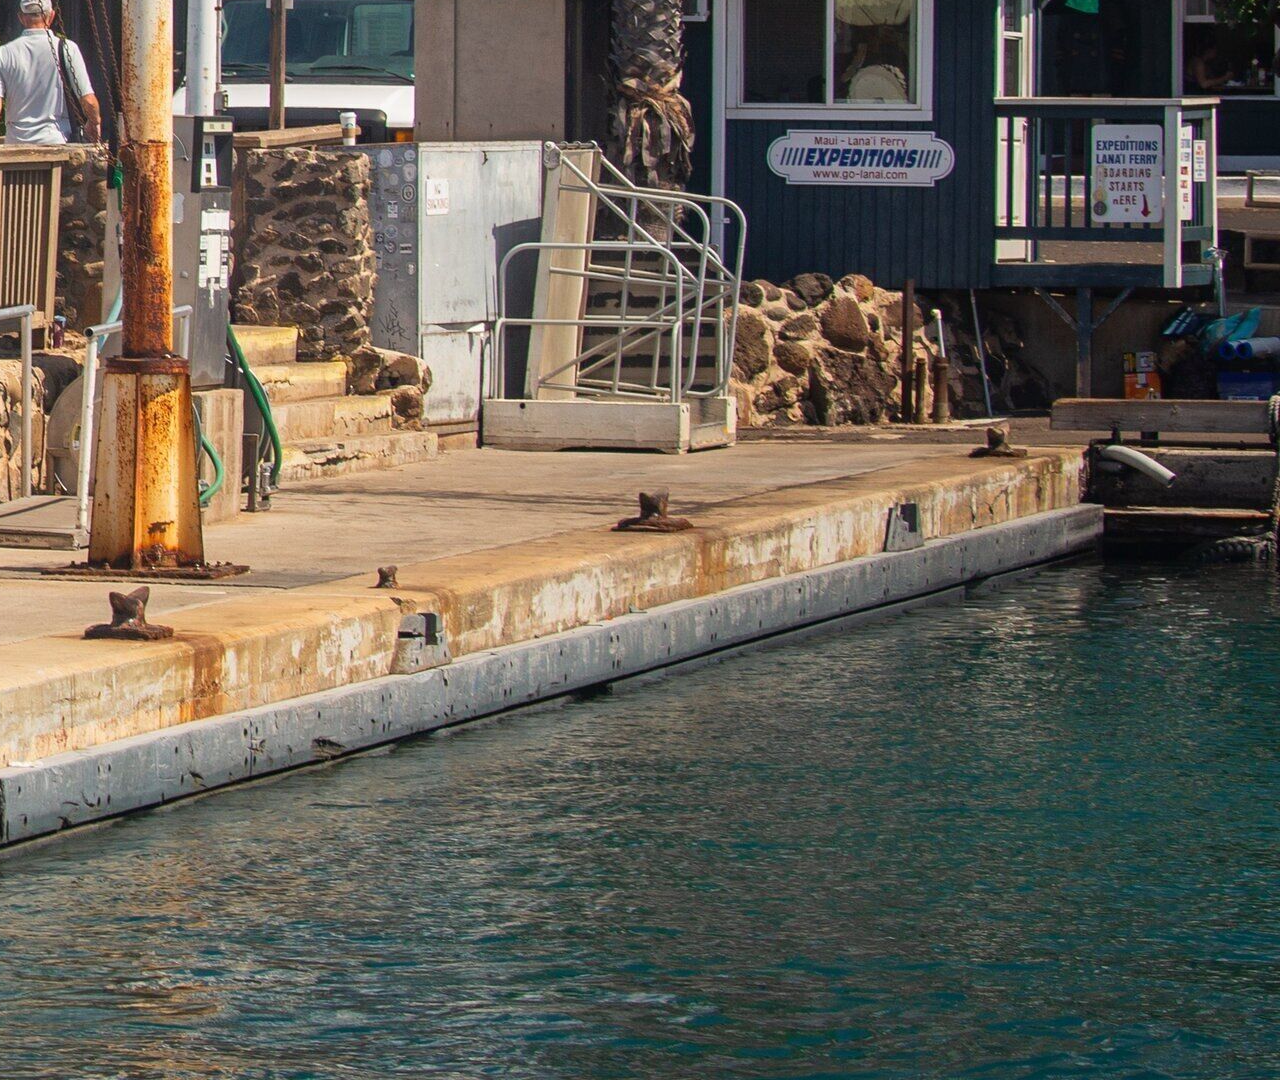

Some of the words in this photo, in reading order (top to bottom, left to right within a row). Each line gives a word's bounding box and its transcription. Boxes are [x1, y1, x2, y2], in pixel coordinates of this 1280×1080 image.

[814, 136, 838, 146] Maui
[880, 138, 908, 148] Ferry
[1096, 140, 1158, 151] EXPEDITIONS
[804, 148, 918, 168] EXPEDITIONS
[1129, 154, 1158, 165] FERRY
[812, 170, 908, 181] www.go-lanai.com
[1109, 182, 1145, 192] STARTS
